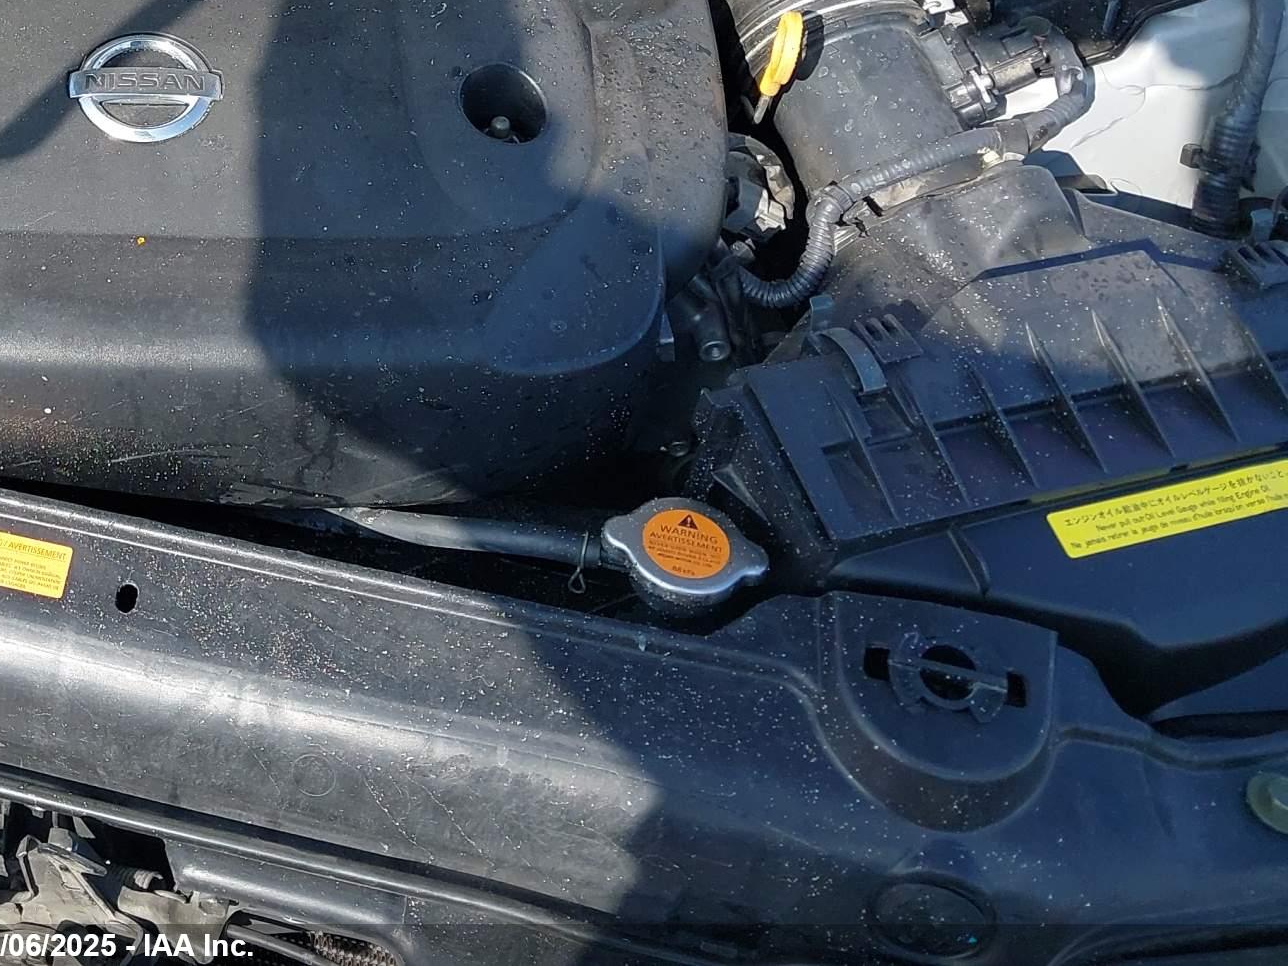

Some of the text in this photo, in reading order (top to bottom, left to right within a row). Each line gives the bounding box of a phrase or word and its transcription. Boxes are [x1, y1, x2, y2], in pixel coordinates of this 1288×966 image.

[84, 72, 206, 91] NISSAN
[650, 531, 722, 552] AVERTISSEMENT
[660, 524, 718, 544] WARNING
[8, 542, 66, 560] AVERTISSEMENT
